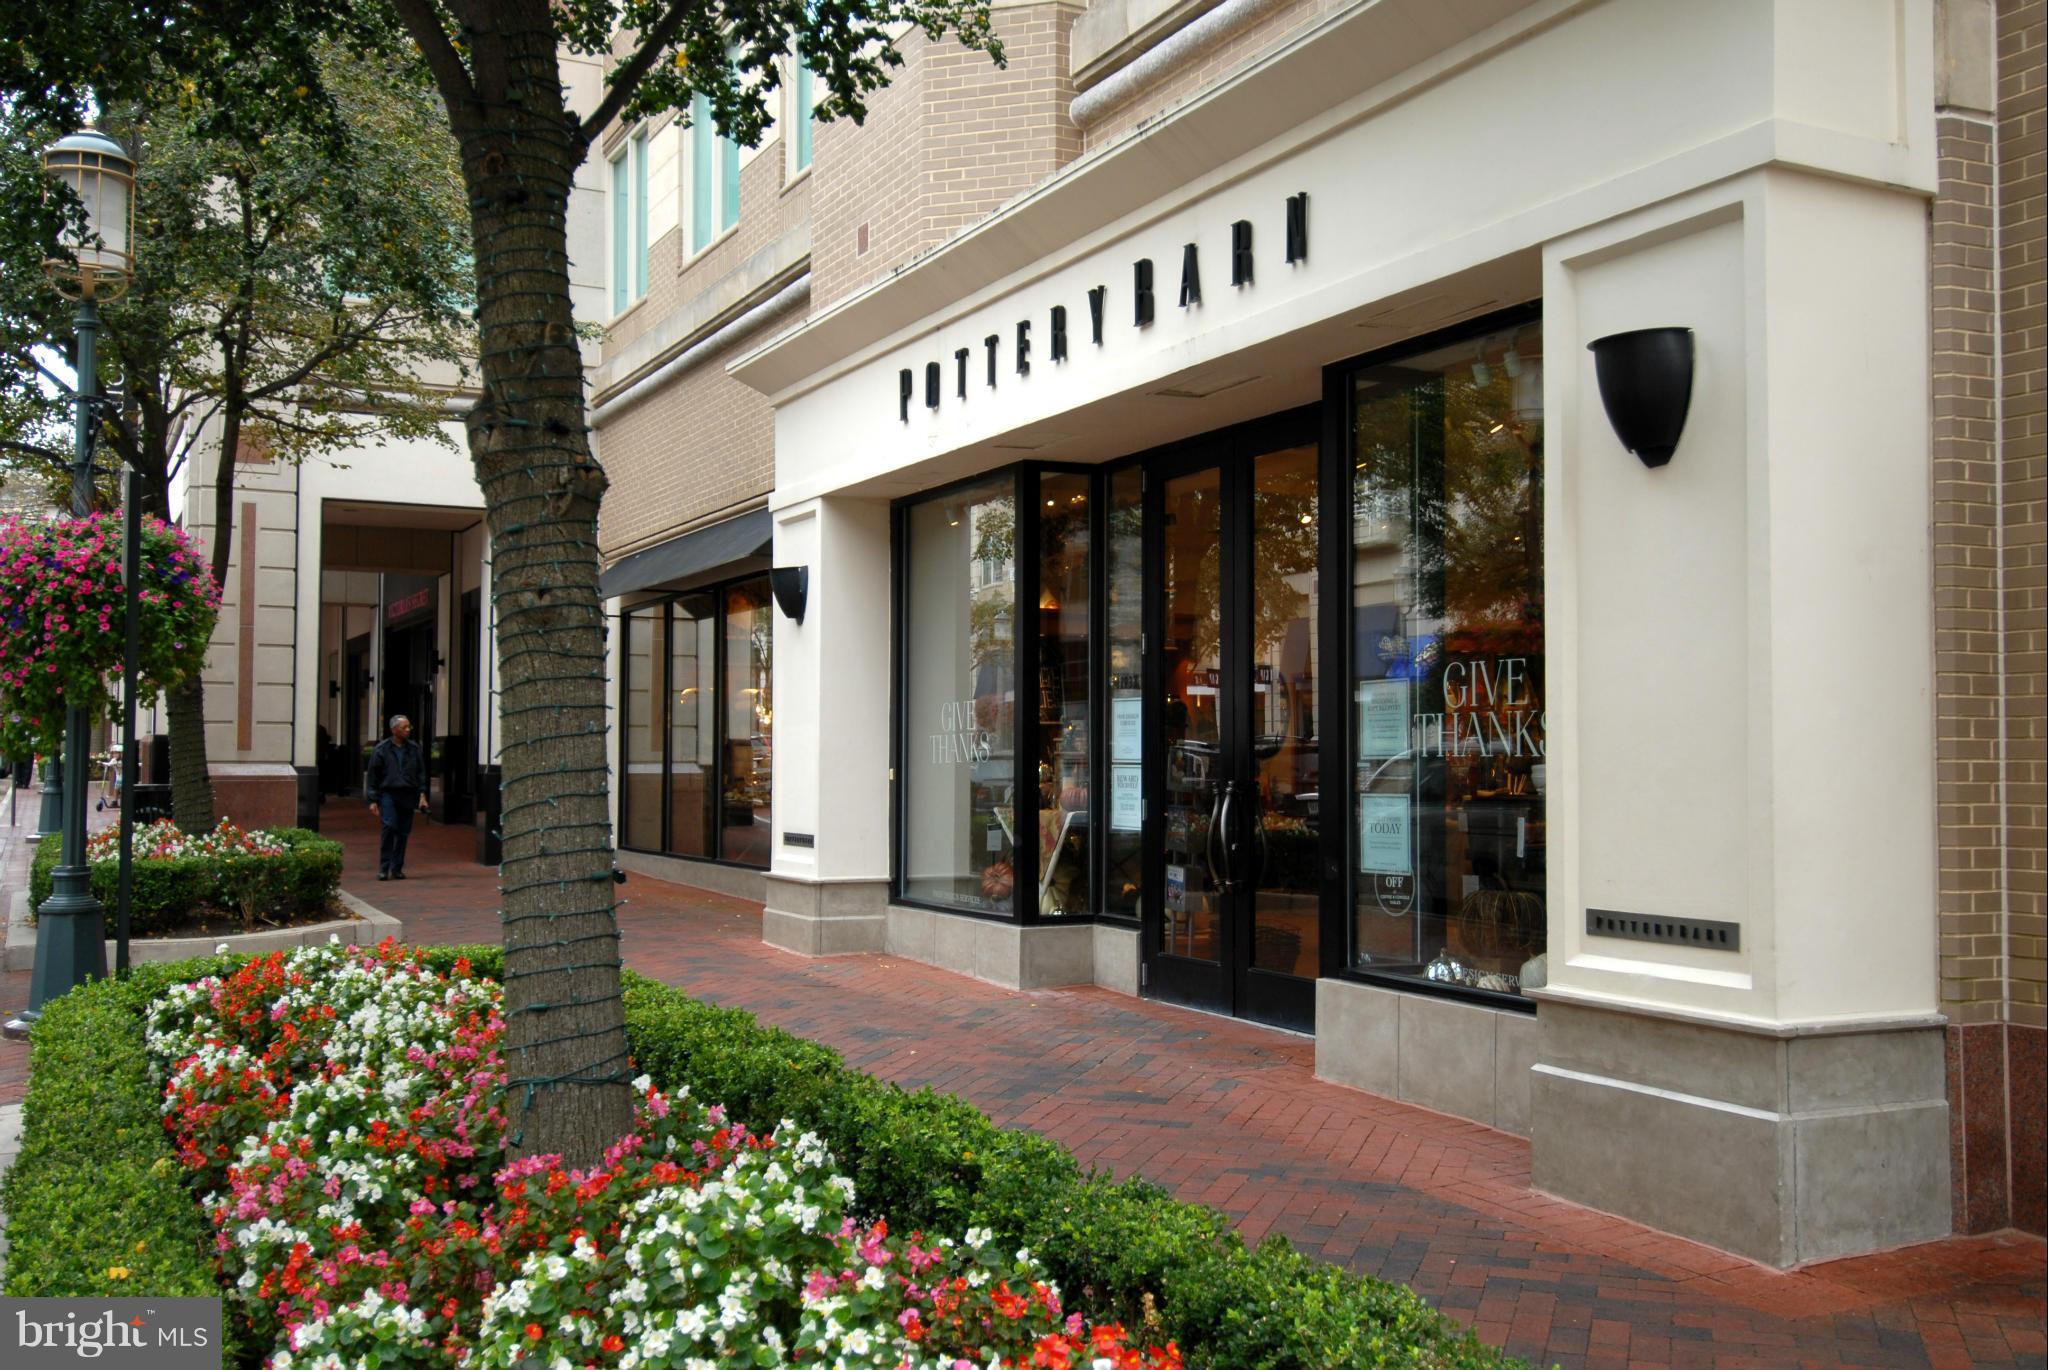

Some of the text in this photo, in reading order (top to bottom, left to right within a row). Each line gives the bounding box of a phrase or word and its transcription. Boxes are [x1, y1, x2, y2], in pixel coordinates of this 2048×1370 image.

[1443, 658, 1528, 708] GIVE
[942, 700, 977, 732] GIVE
[930, 731, 991, 764] THANKS
[1369, 822, 1402, 834] TODAY
[1385, 876, 1404, 888] OFF
